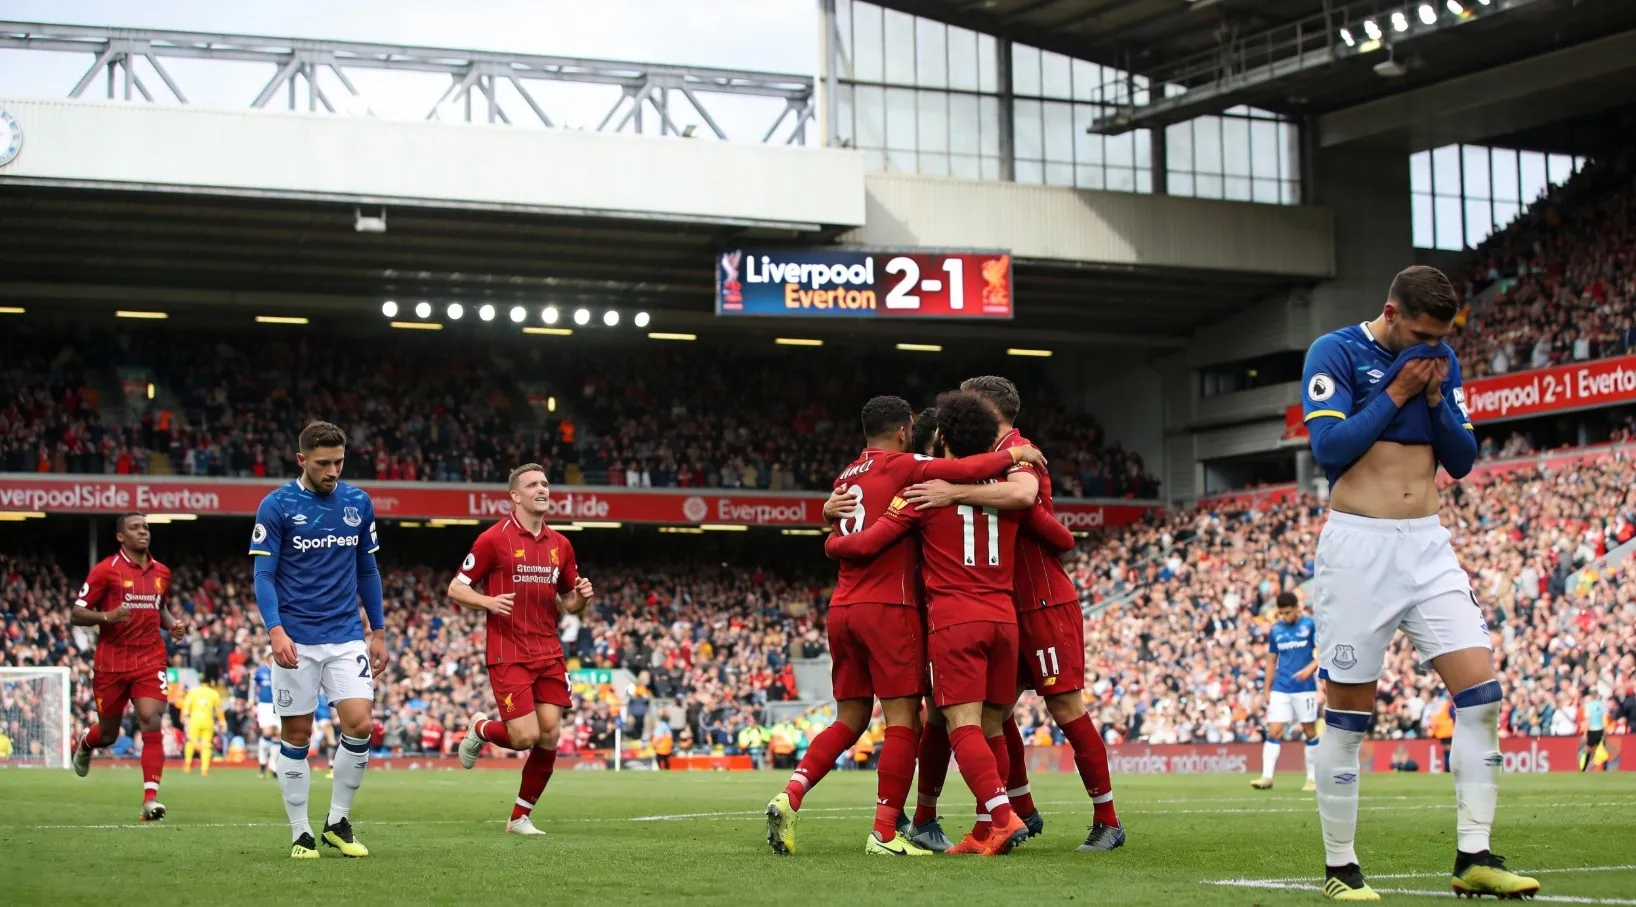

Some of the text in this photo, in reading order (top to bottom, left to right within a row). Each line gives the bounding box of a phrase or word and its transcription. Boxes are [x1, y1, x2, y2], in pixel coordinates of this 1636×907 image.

[746, 255, 964, 310] Liverpool 2-1
[784, 282, 877, 310] Everton
[1543, 372, 1572, 404] 2-1
[136, 485, 219, 509] Everton
[957, 504, 999, 567] 11
[1036, 646, 1059, 677] 11
